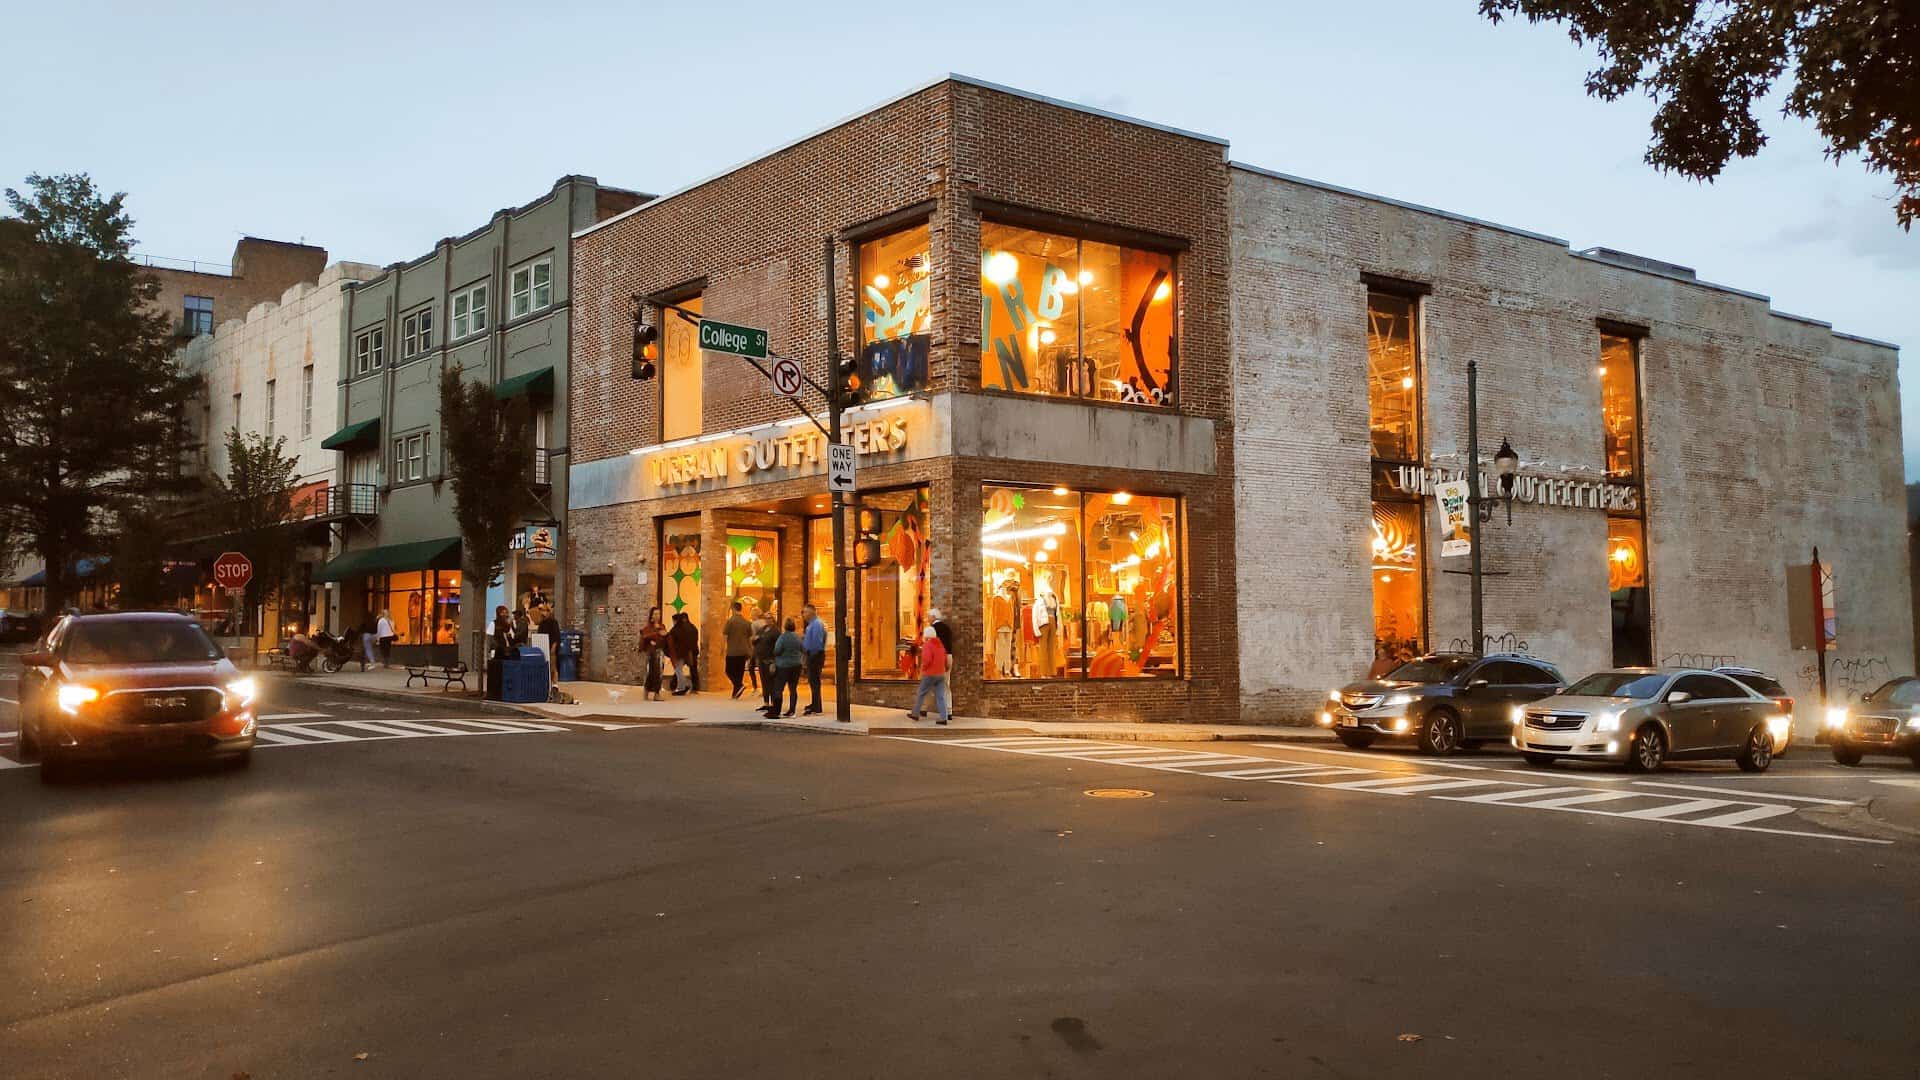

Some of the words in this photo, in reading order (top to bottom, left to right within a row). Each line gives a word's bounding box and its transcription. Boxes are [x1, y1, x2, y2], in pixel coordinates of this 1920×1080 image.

[702, 325, 747, 352] College
[756, 334, 765, 347] St
[652, 447, 728, 487] URBAN
[735, 417, 908, 474] OUTFITERS
[832, 447, 851, 460] ONE
[832, 460, 852, 472] WAY
[217, 563, 249, 578] STOP
